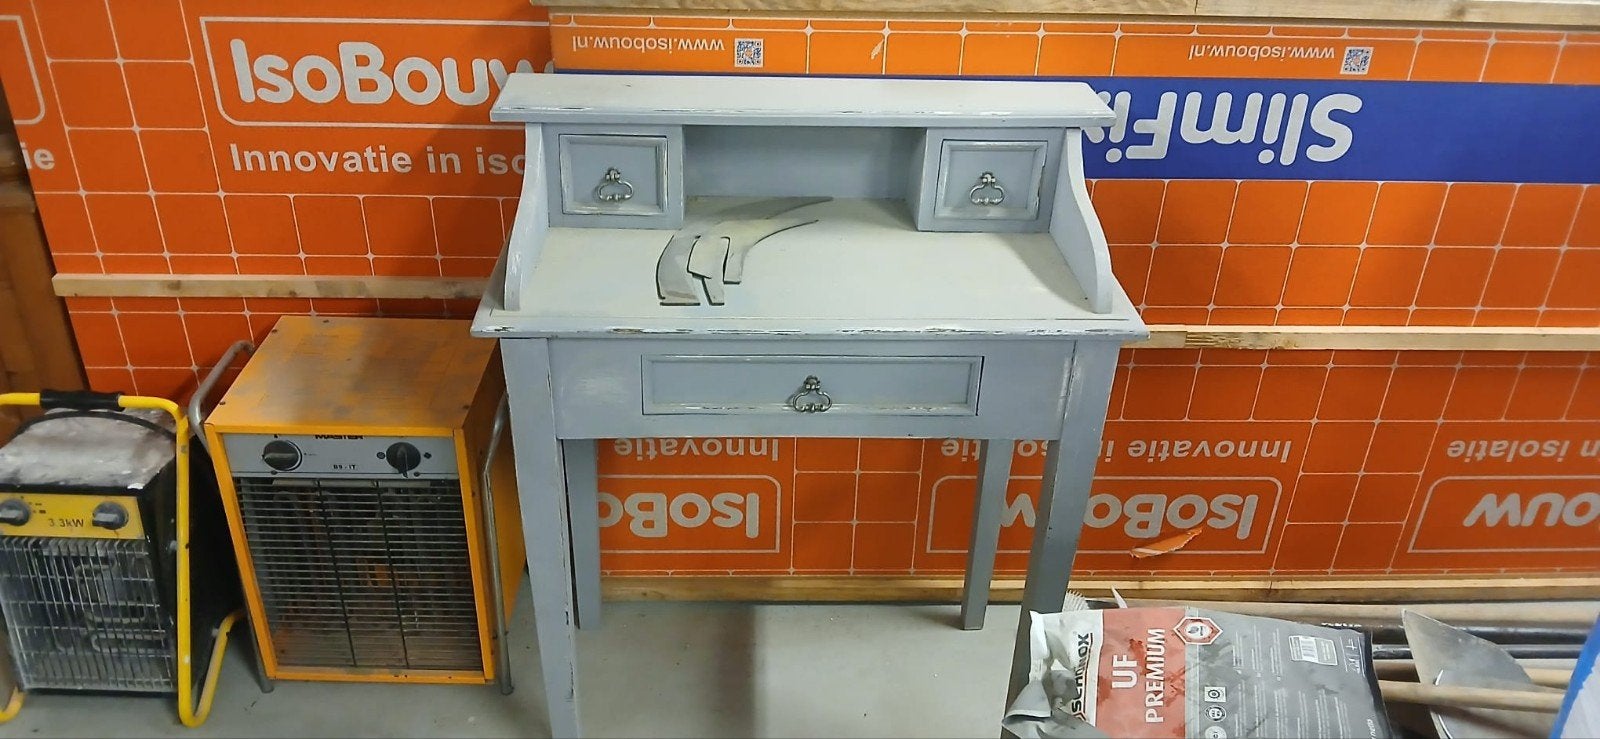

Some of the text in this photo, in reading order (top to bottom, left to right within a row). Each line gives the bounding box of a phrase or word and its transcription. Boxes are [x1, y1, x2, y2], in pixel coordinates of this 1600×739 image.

[572, 36, 725, 52] www.isobouw.nl
[1188, 44, 1335, 61] www.isobouw.nl
[230, 143, 412, 173] Innovatie
[427, 147, 461, 174] in
[614, 439, 779, 461] Innovatie
[1128, 440, 1292, 462] Innovatie
[1447, 439, 1570, 462] isolatie
[48, 518, 84, 528] 33kW
[1111, 653, 1139, 690] UF
[1145, 628, 1166, 723] PREMIUM
